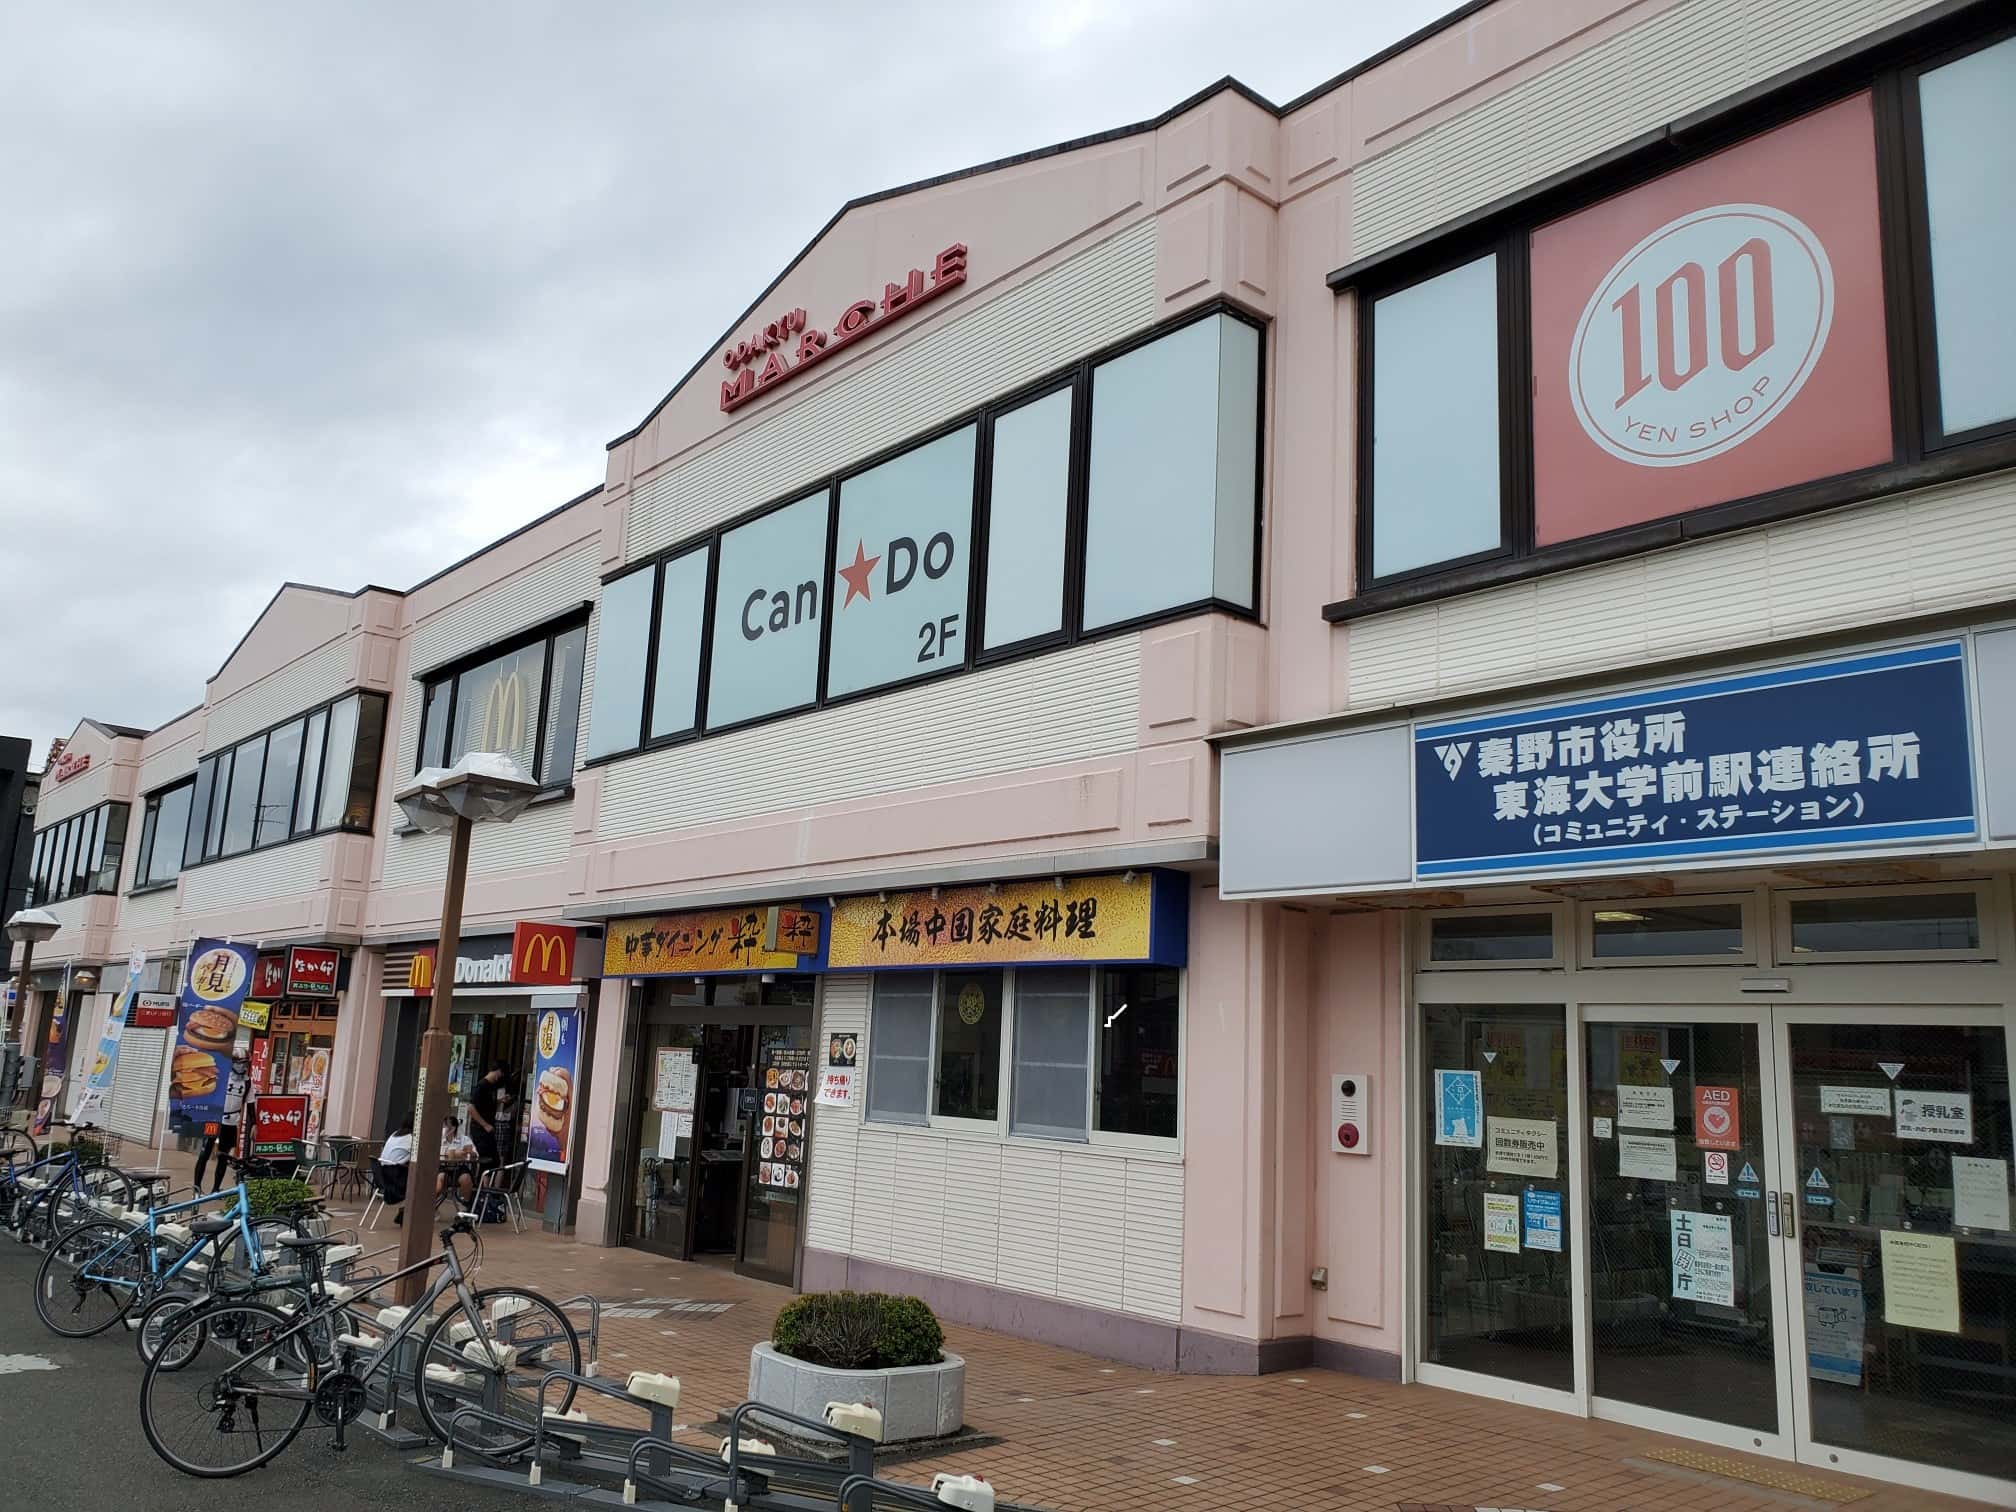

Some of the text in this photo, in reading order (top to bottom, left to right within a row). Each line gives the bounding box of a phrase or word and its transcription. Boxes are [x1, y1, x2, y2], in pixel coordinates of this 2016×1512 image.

[720, 242, 967, 413] MARCHE
[723, 307, 806, 370] ODAKYU
[1612, 237, 1775, 410] 100
[1623, 376, 1770, 442] YEN SHOP
[741, 580, 818, 641] Can
[917, 614, 959, 663] 2F
[1477, 710, 1687, 778] 秦野市役所
[1493, 730, 1921, 822] 東海大学前駅連絡所
[625, 927, 724, 963] 中華ダイニング
[872, 897, 1098, 951] 本場中国家庭料理
[206, 954, 230, 993] 月見
[295, 958, 334, 976] なか卯
[826, 1074, 851, 1086] 持ち帰り
[1703, 1090, 1730, 1101] AED
[259, 1110, 302, 1126] なか卯
[1920, 1104, 1966, 1120] 授乳室
[1495, 1137, 1545, 1151] 回数券販売中
[1674, 1214, 1695, 1291] 土日開庁
